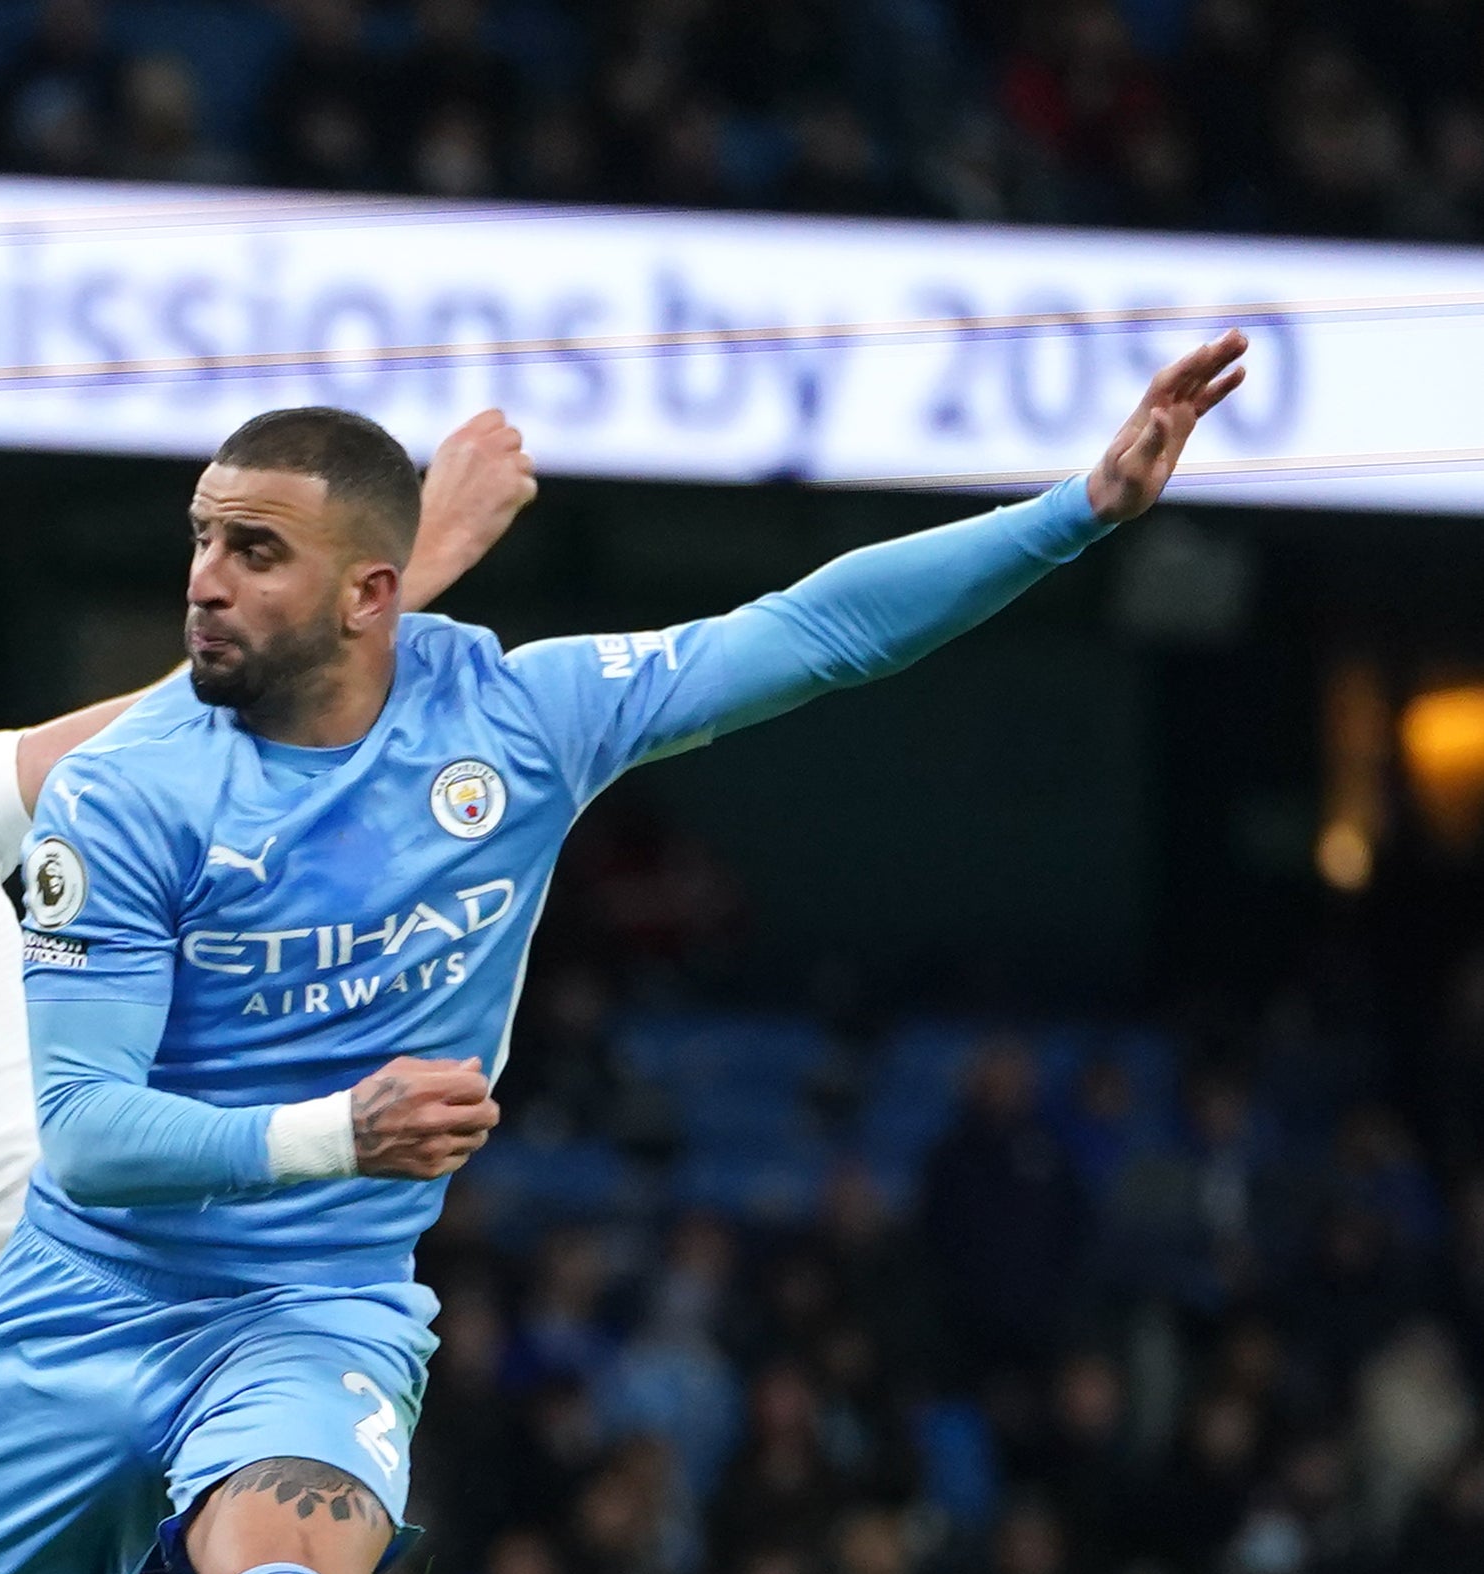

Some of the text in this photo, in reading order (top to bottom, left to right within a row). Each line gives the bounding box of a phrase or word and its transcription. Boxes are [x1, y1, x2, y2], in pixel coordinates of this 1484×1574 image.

[653, 258, 861, 484] by
[182, 878, 515, 974] ETIHAD
[242, 951, 467, 1017] AIRWAYS
[341, 1370, 401, 1480] 2
